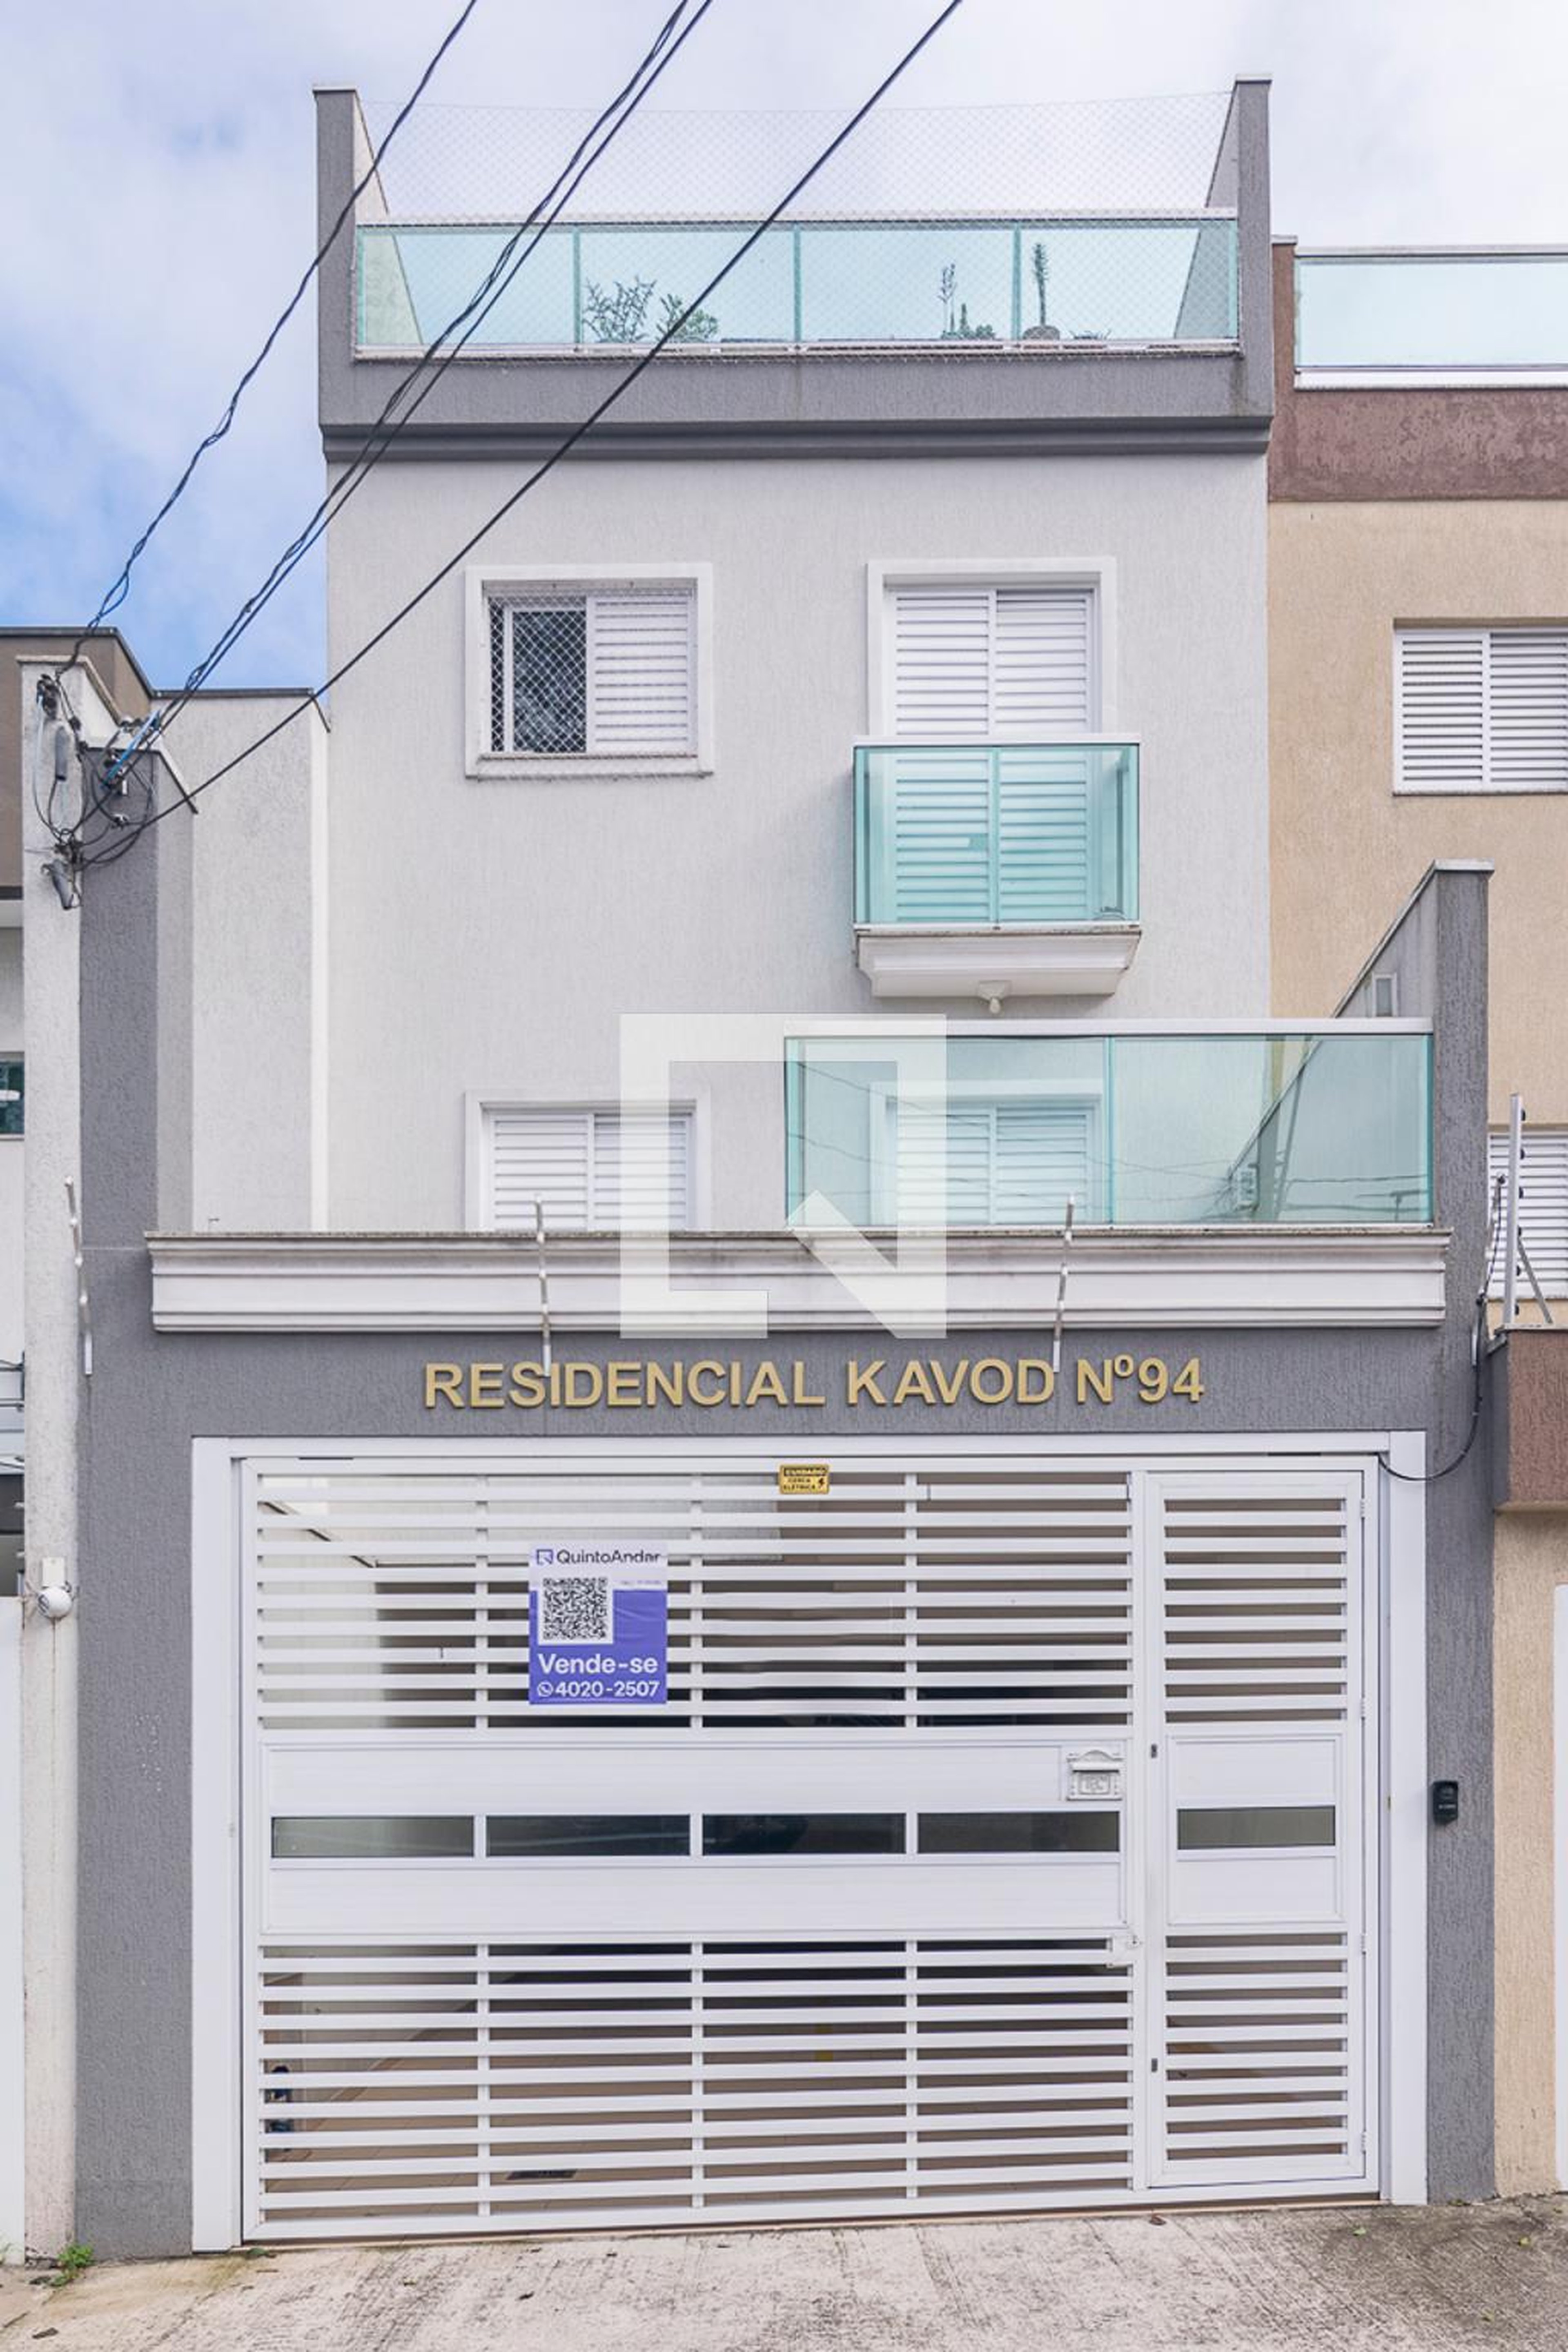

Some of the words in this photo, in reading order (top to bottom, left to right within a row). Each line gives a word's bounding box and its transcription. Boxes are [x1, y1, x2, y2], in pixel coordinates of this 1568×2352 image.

[425, 1361, 826, 1408] RESIDENCIAL
[846, 1359, 1055, 1404] KAVOD
[1076, 1354, 1205, 1404] Nº94
[557, 1549, 661, 1564] QuintoAndar
[538, 1654, 658, 1674] Vende-se
[555, 1681, 660, 1697] 4020-2507
